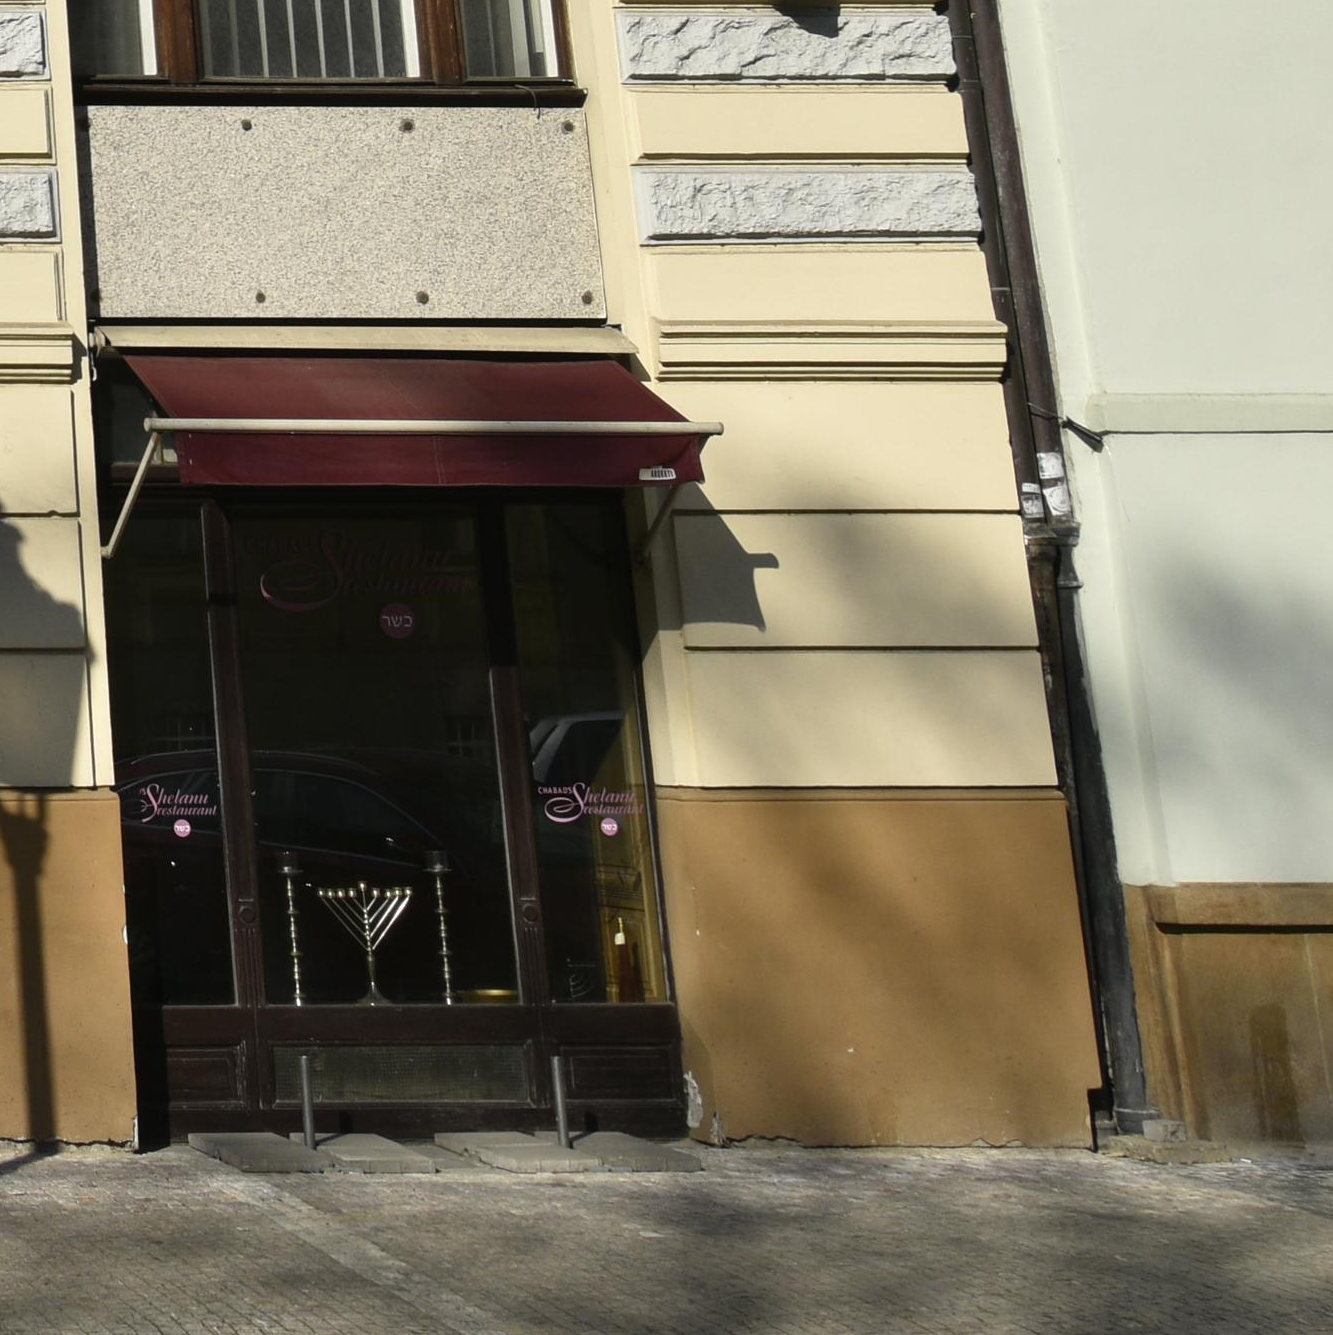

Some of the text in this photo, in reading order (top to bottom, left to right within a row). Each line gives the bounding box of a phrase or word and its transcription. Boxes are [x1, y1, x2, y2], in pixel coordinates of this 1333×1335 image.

[381, 615, 413, 628] כשר
[156, 804, 218, 816] restaurant
[583, 802, 645, 815] restaurant
